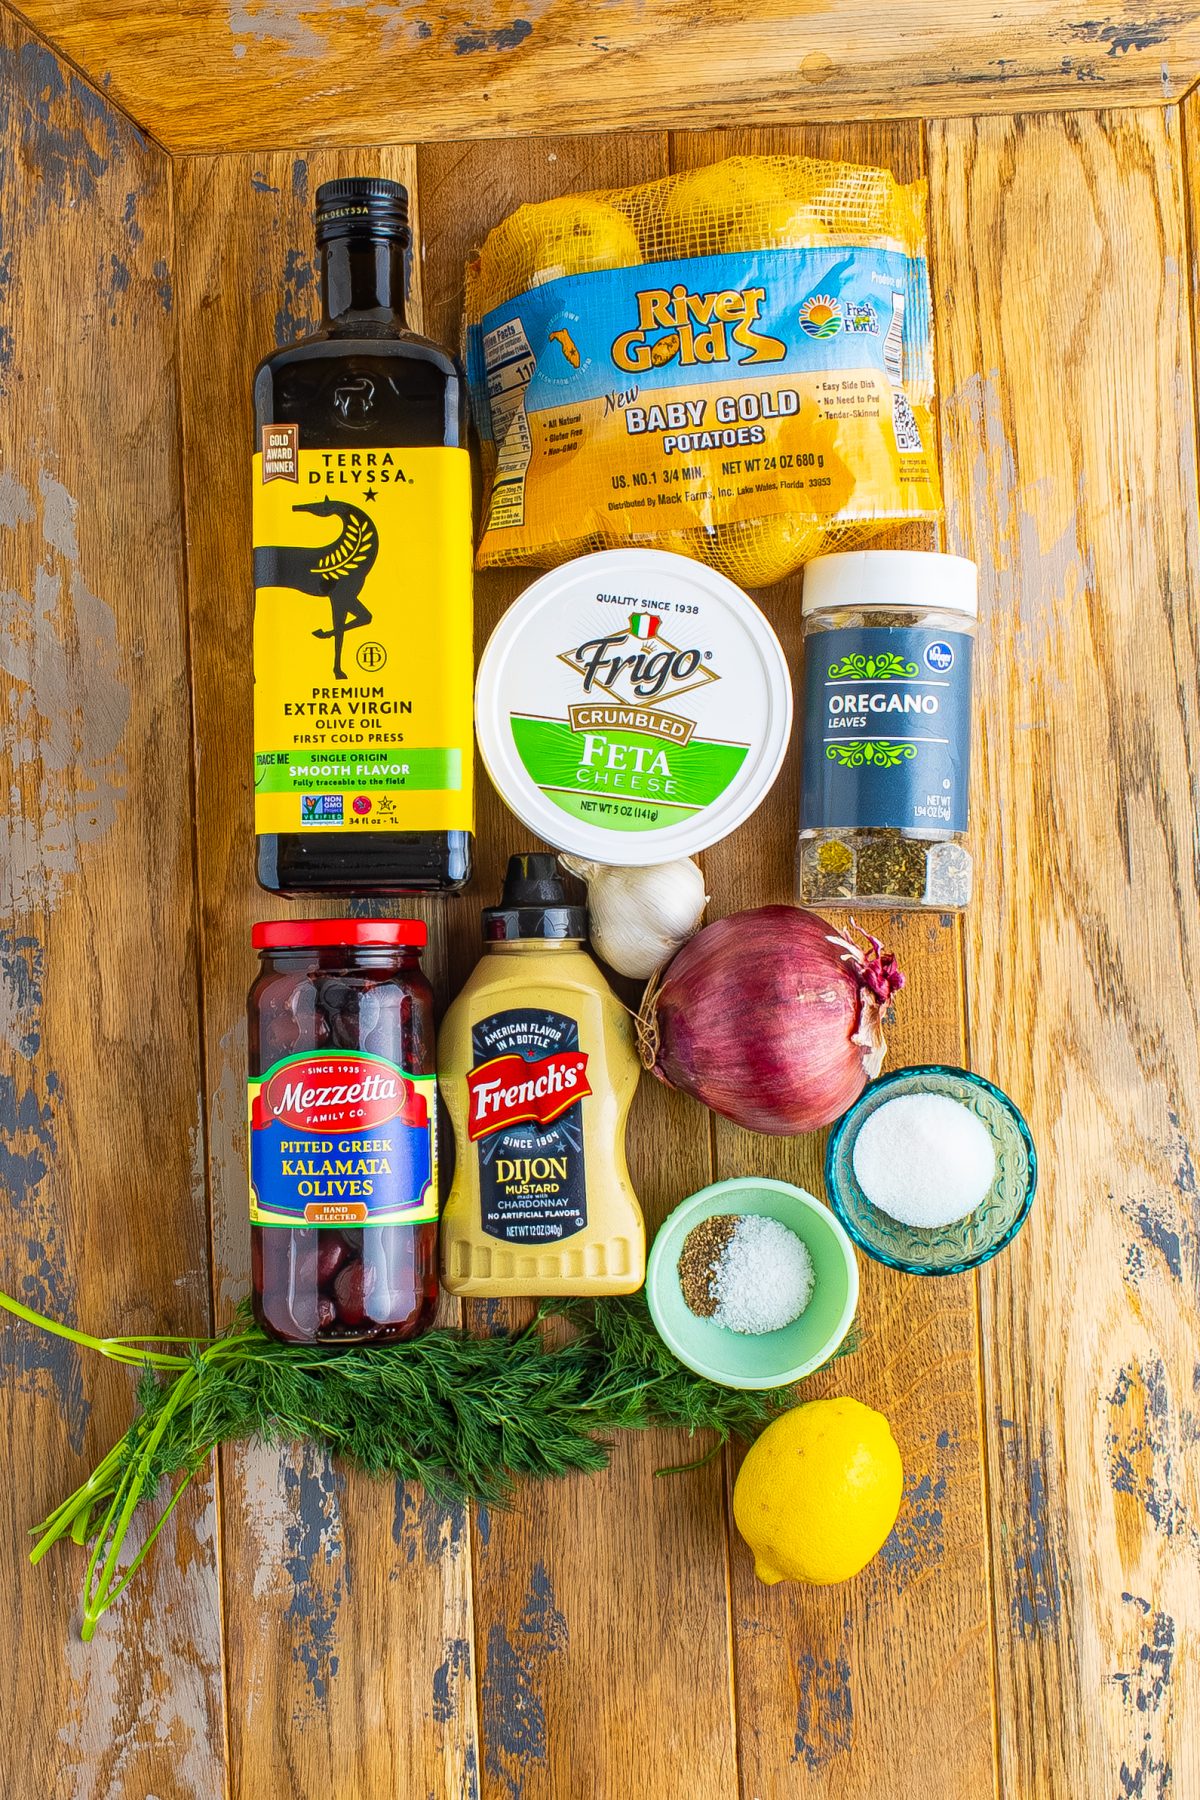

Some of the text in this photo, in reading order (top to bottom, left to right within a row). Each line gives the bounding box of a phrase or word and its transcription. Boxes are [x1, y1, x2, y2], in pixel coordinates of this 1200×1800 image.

[330, 206, 368, 218] DELYSSA
[636, 284, 766, 331] River
[846, 302, 876, 316] Fresh
[844, 319, 879, 334] Florida
[822, 380, 875, 391] Easy Side Dish
[603, 385, 639, 418] New
[824, 397, 834, 405] No
[836, 396, 854, 404] Need
[858, 395, 864, 403] to
[625, 389, 800, 435] BABY GOLD
[825, 410, 880, 420] Tender-Skinned
[549, 414, 581, 428] All Natural
[270, 435, 288, 446] GOLD
[549, 429, 582, 442] Gluten Free
[663, 425, 765, 455] POTATOES
[267, 448, 292, 460] AWARD
[322, 453, 393, 466] TERRA
[266, 462, 294, 473] WINNER
[722, 454, 824, 476] NET WT 24 OZ 680 g
[309, 470, 406, 484] DELYSSA
[612, 467, 705, 490] US. NO.1 3/4 MIN.
[608, 498, 645, 511] Distributed
[647, 497, 656, 507] By
[658, 493, 682, 505] Mack
[718, 486, 734, 498] Inc.
[737, 486, 753, 496] Lake
[756, 484, 778, 493] Wales,
[780, 481, 804, 490] Florida
[596, 594, 699, 614] QUALITY SINCE 1938
[929, 646, 950, 668] Kroger
[576, 635, 702, 698] Frigo
[312, 687, 384, 698] PREMIUM
[284, 702, 412, 715] EXTRA VIRGIN
[829, 694, 938, 714] OREGANO
[316, 719, 382, 729] OLIVE OIL
[577, 711, 685, 737] CRUMBLED
[828, 717, 866, 728] LEAVES
[294, 733, 404, 743] FIRST COLD PRESS
[256, 754, 289, 765] TRACE ME
[311, 754, 388, 762] SINGLE ORIGIN
[578, 734, 672, 776] FETA
[289, 764, 410, 777] SMOOTH FLAVOR
[294, 779, 313, 787] Fully
[316, 778, 355, 786] traceable
[576, 769, 677, 794] CHEESE
[927, 795, 951, 806] NET WT
[581, 801, 658, 822] NET WT 5 OZ (141g)
[914, 806, 926, 816] 1.94
[927, 807, 937, 817] OZ
[485, 1024, 561, 1045] AMERICAN FLAVOR
[496, 1035, 550, 1051] IN A BOTTLE
[308, 1066, 359, 1074] SINCE 1935
[273, 1074, 397, 1115] Mezzetta
[473, 1064, 577, 1120] French's
[306, 1109, 366, 1123] FAMILY CO.
[280, 1140, 392, 1153] PITTED GREEK
[503, 1131, 559, 1148] SINCE 1904
[281, 1158, 391, 1176] KALAMATA
[496, 1157, 567, 1184] DIJON
[298, 1180, 373, 1196] OLIVES
[506, 1184, 559, 1194] MUSTARD
[498, 1198, 568, 1209] CHARDONNAY
[501, 1211, 543, 1219] ARTIFICIAL
[507, 1226, 517, 1236] NET
[518, 1226, 529, 1236] WT
[530, 1226, 536, 1236] 12
[536, 1225, 544, 1235] OZ
[545, 1224, 562, 1237] (340g)
